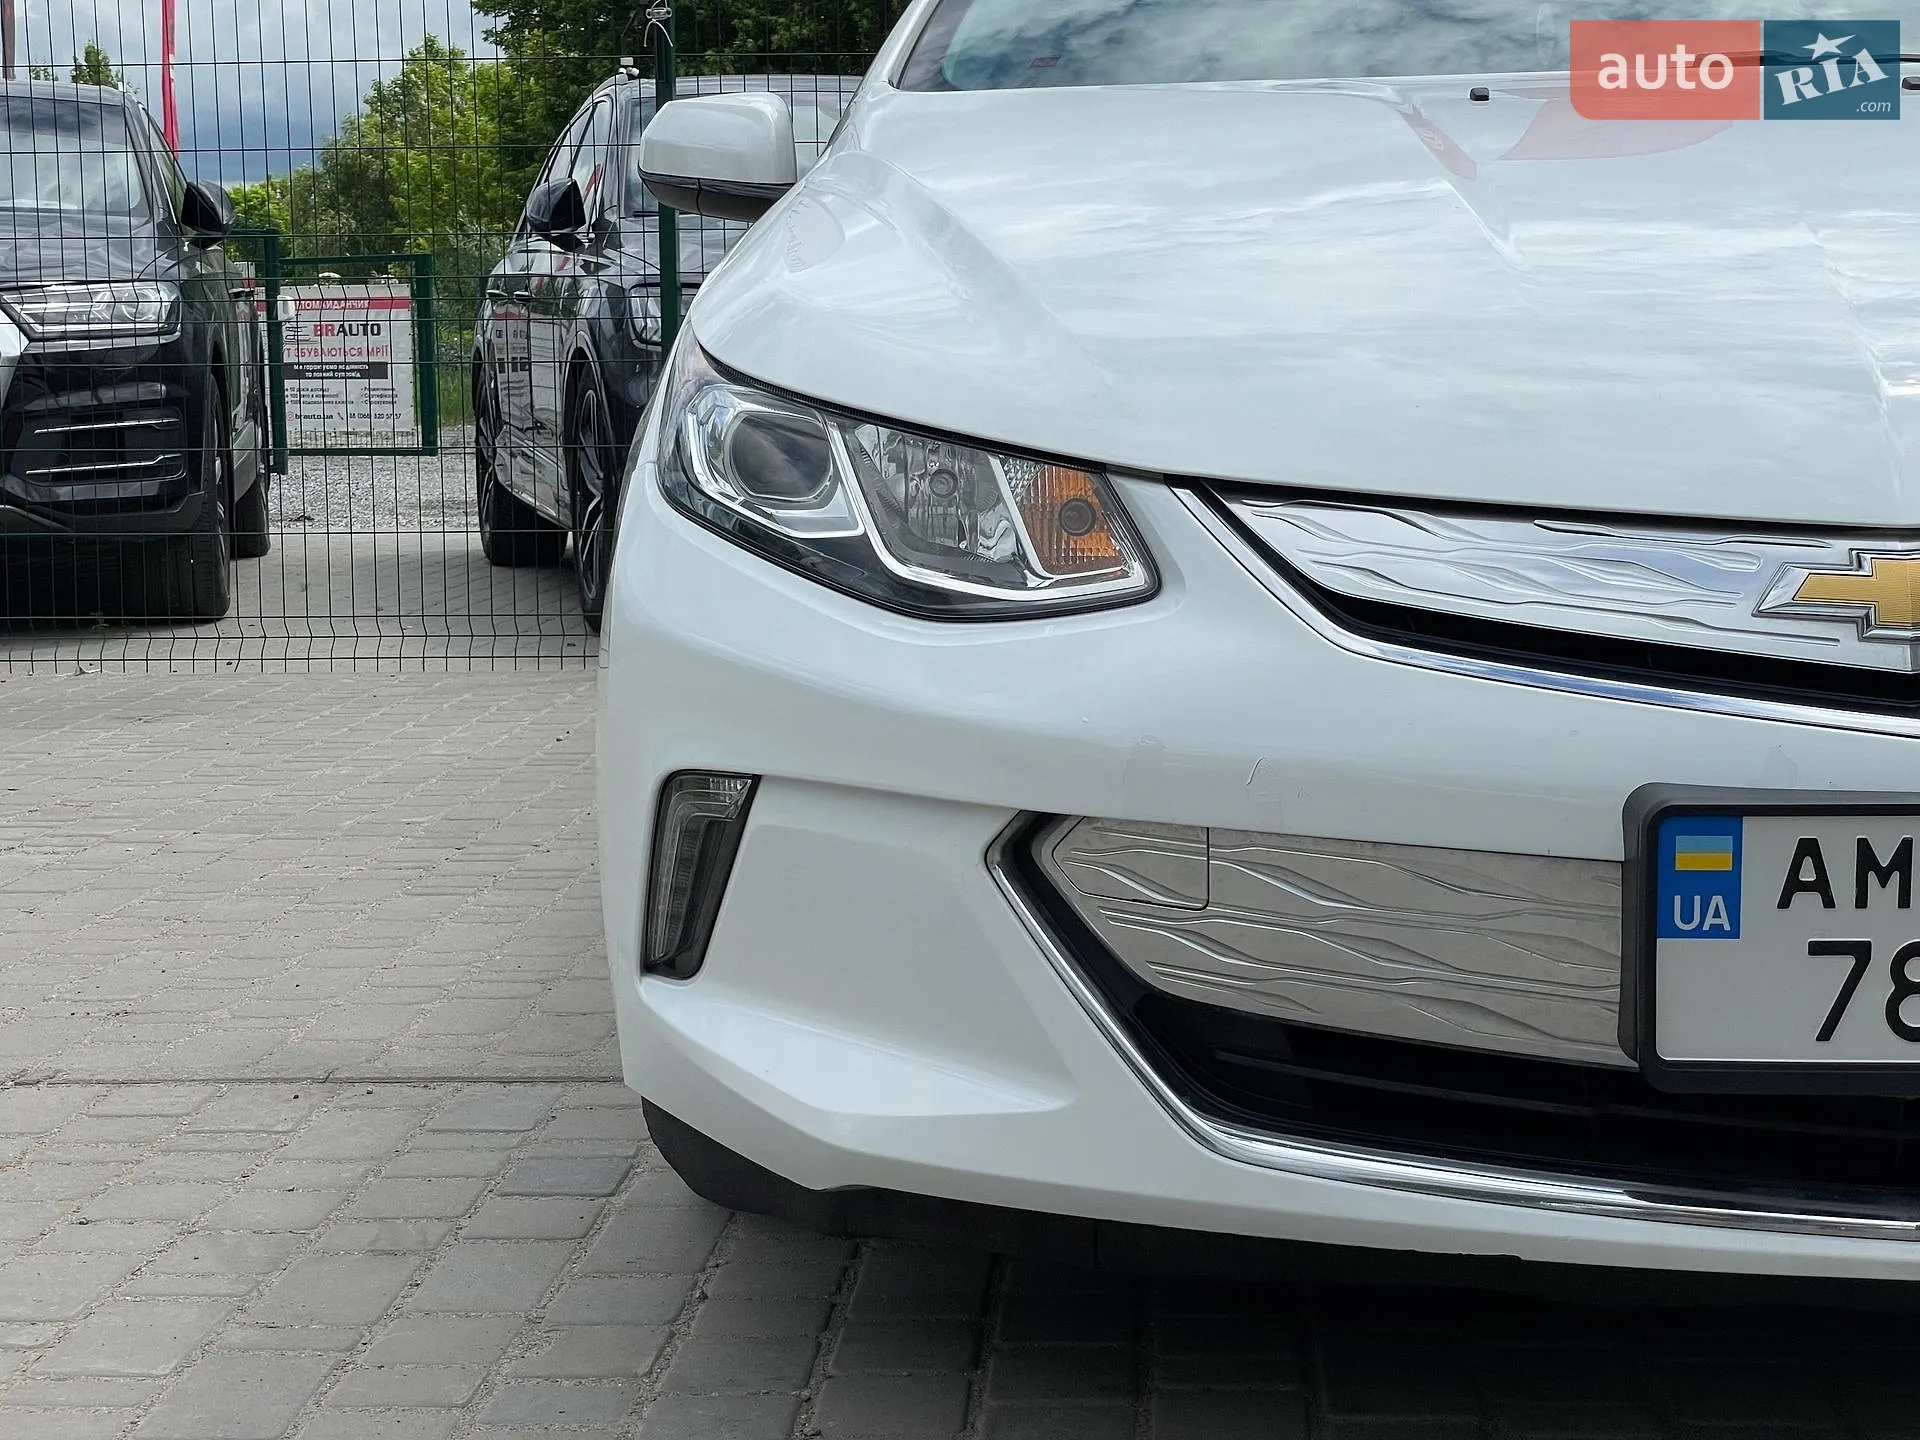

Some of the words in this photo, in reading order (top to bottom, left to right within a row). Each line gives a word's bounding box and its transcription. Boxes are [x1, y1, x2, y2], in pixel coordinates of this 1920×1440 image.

[313, 323, 381, 337] BRAUTO
[1776, 836, 1914, 910] AM
[1673, 895, 1732, 931] UA
